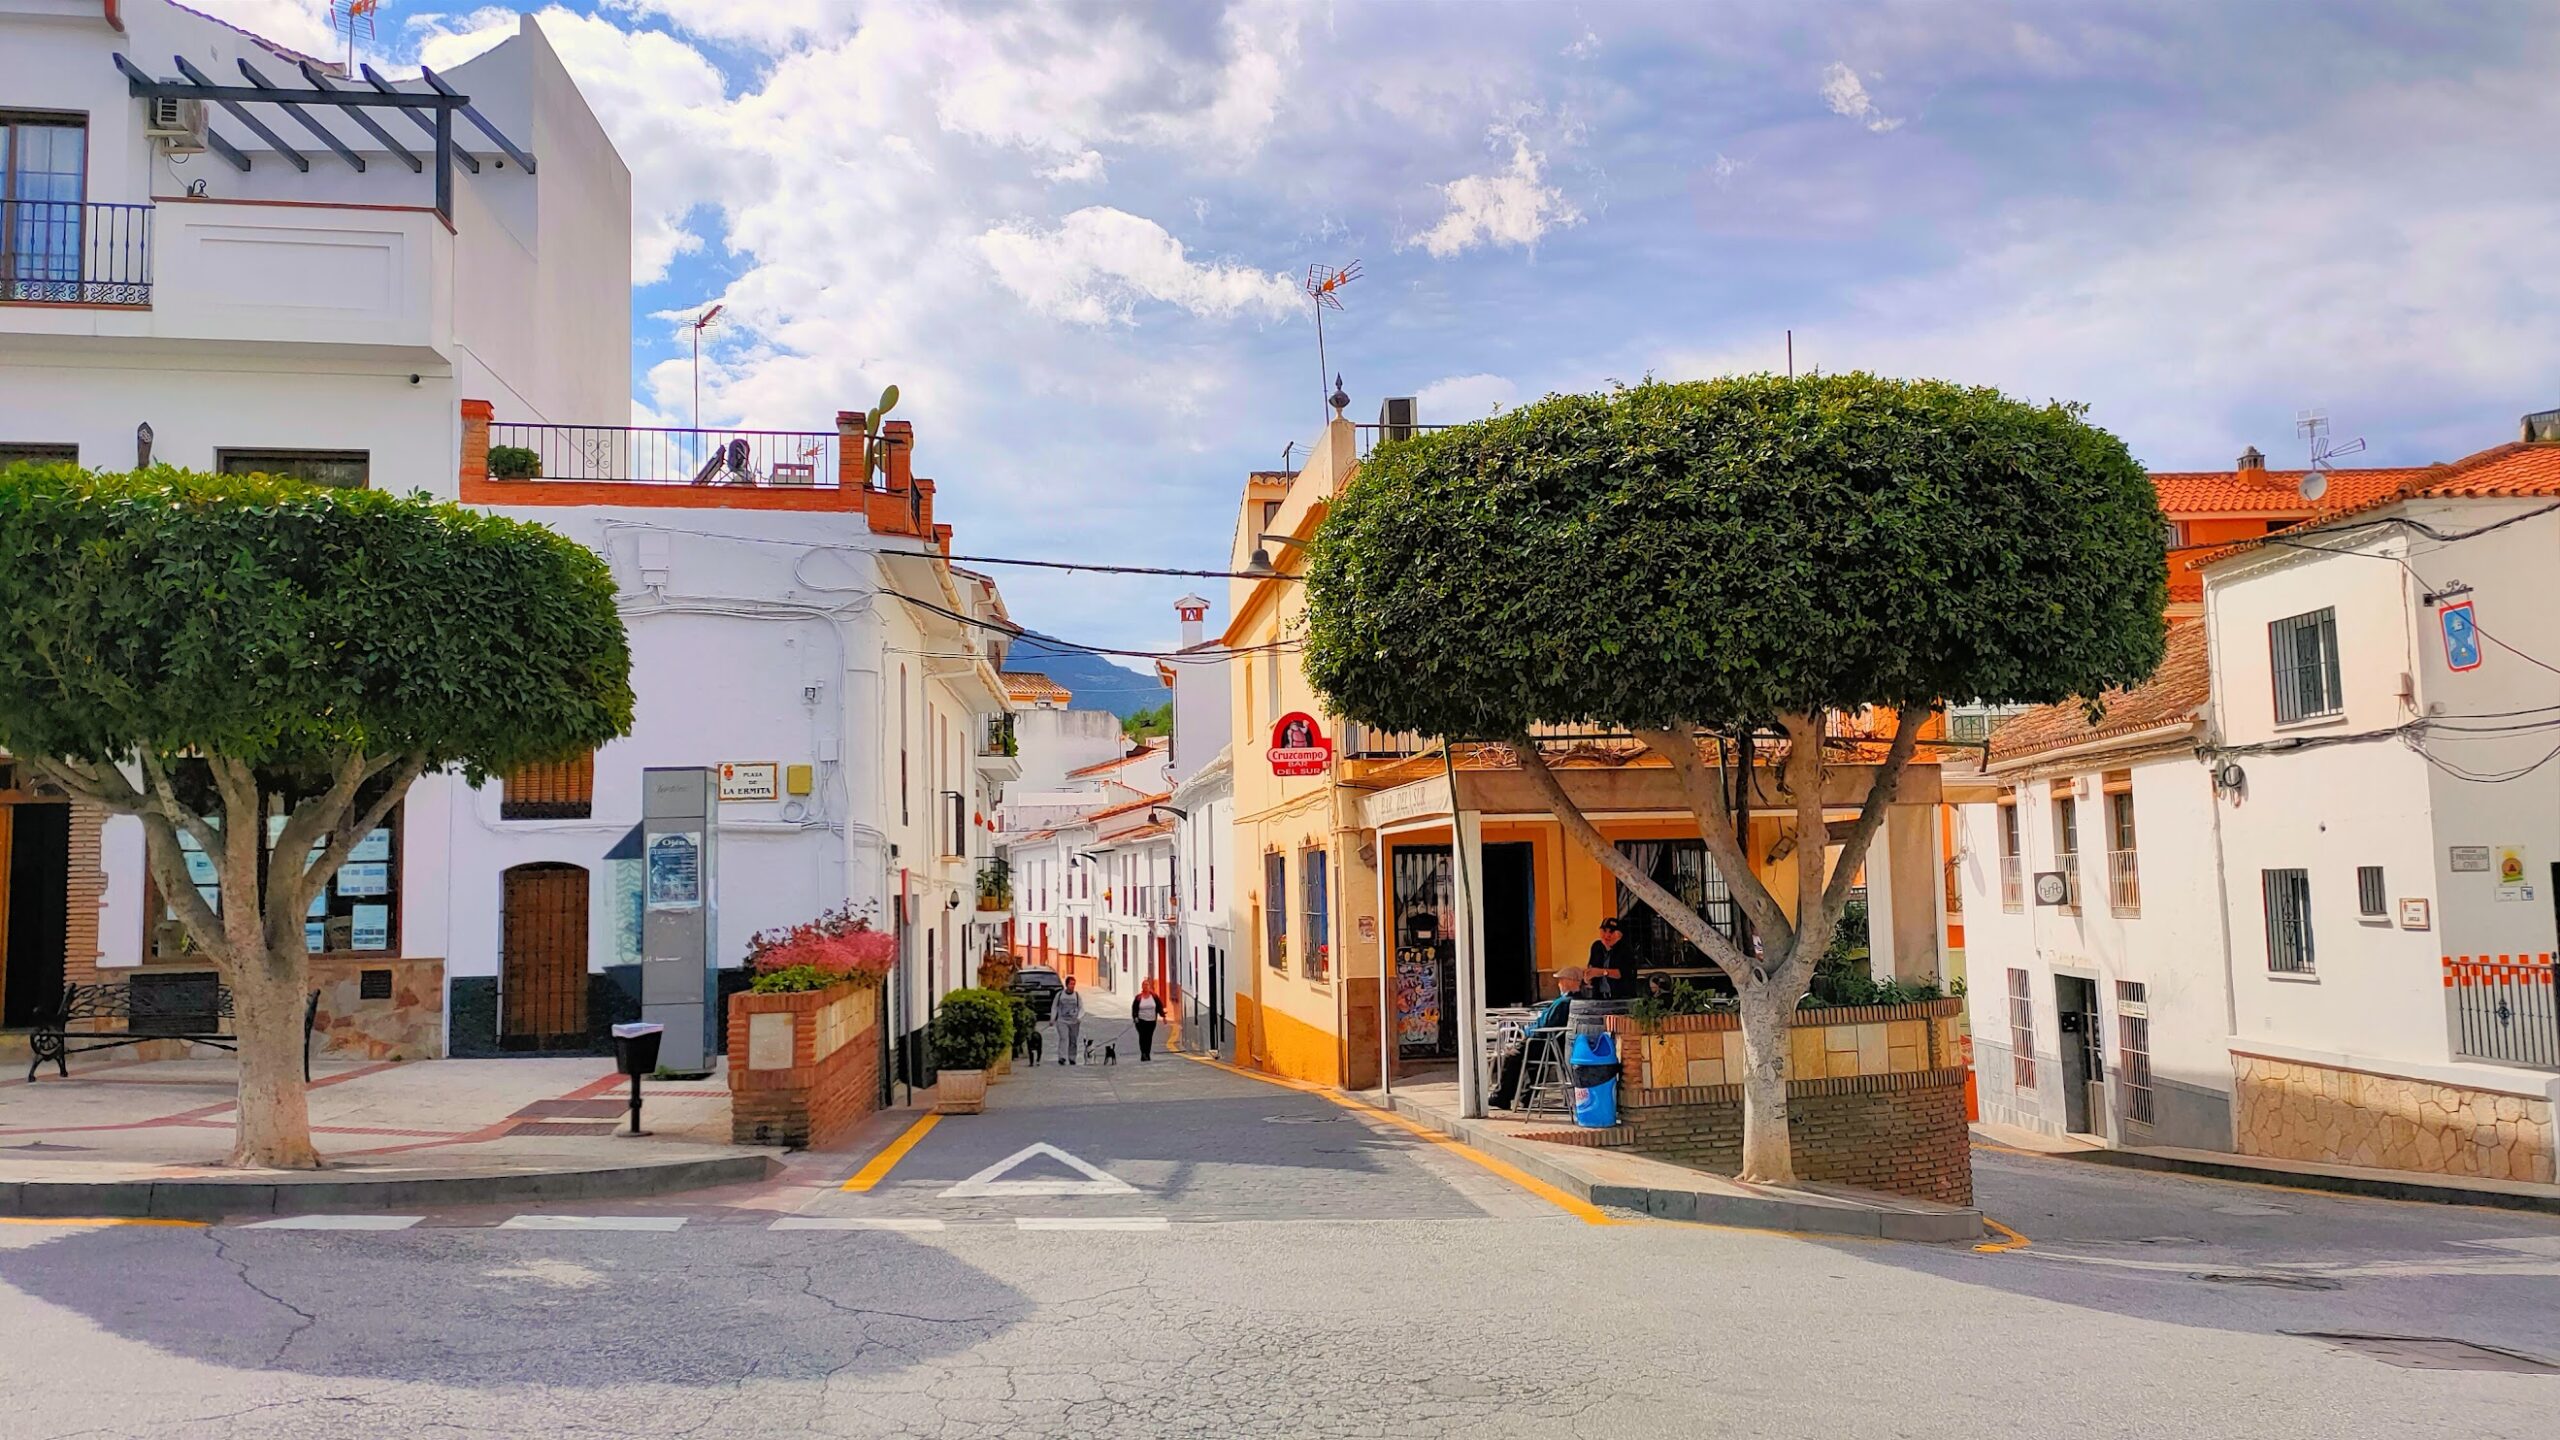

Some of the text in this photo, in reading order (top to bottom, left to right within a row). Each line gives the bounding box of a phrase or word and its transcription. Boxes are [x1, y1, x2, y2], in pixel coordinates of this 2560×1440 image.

[1272, 751, 1324, 760] Cruzcampo
[737, 787, 771, 795] ERMITA
[1380, 796, 1393, 815] BAR
[1397, 791, 1408, 811] DEL
[1413, 786, 1426, 807] SUR
